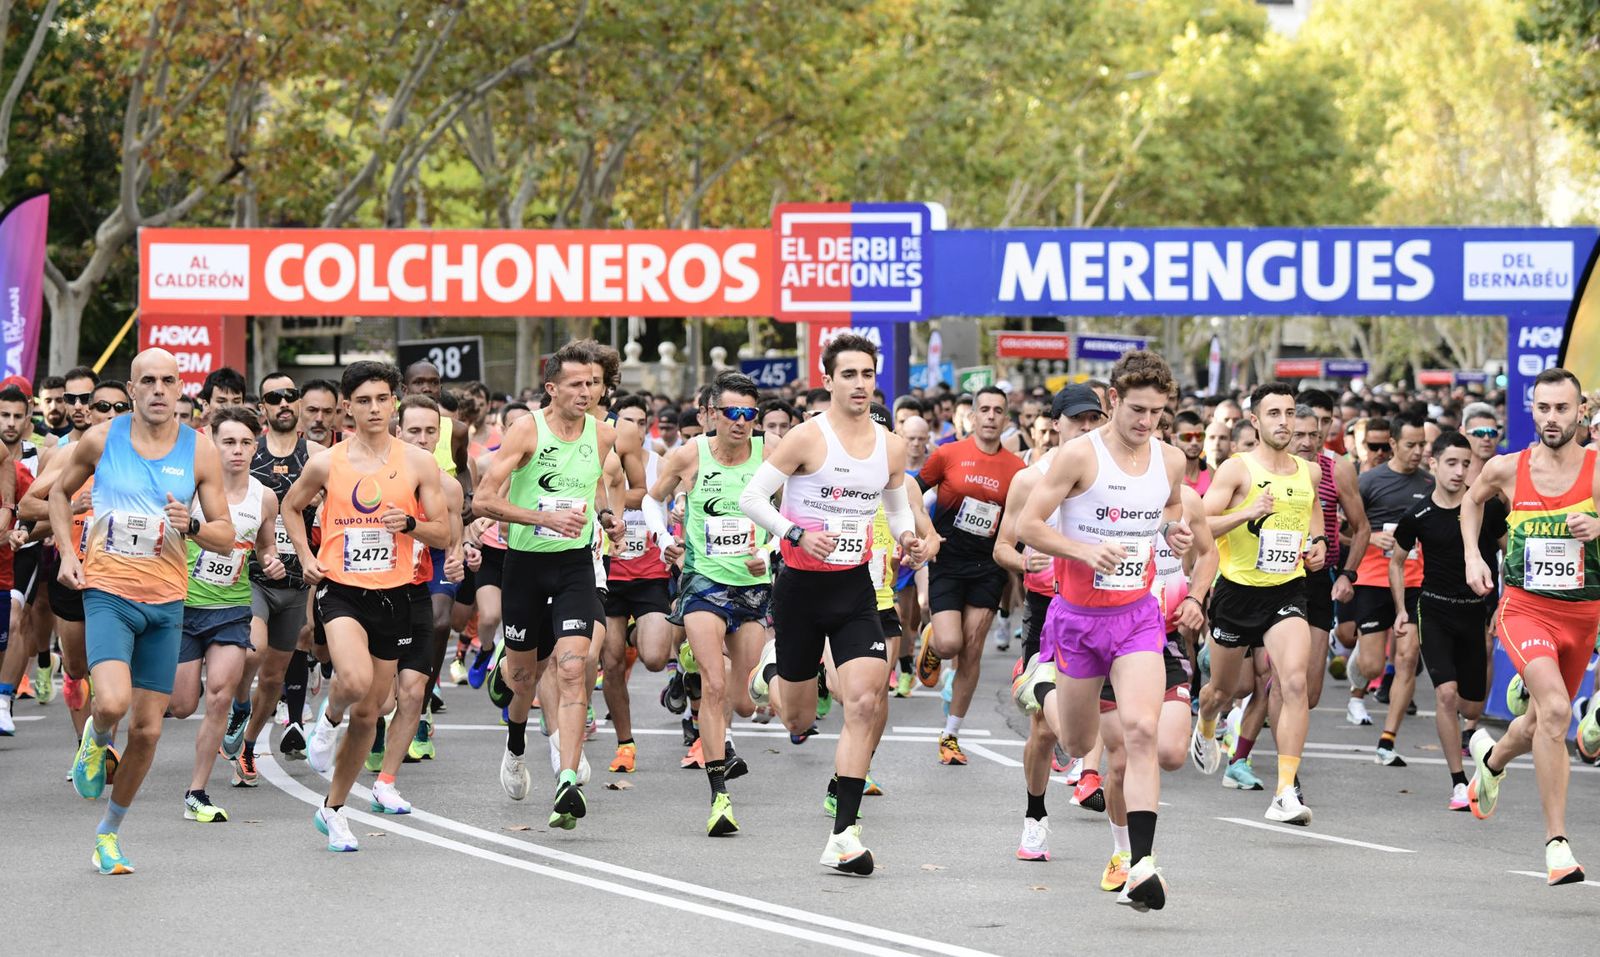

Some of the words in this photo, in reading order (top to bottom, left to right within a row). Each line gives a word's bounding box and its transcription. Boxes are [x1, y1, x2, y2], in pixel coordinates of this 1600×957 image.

[781, 237, 813, 262] EL
[818, 237, 897, 262] DERBI
[901, 237, 921, 250] DE
[190, 255, 210, 269] AL
[1502, 253, 1535, 268] DEL
[154, 269, 244, 288] CALDERÓN
[264, 242, 760, 303] COLCHONEROS
[781, 262, 923, 288] AFICIONES
[998, 239, 1434, 302] MERENGUES
[1468, 267, 1569, 288] BERNABÉU
[149, 325, 210, 346] HOKA
[161, 465, 185, 477] HOKA
[964, 473, 999, 489] NABICO
[334, 517, 363, 526] GRUPO
[964, 512, 992, 530] 1809
[131, 534, 138, 546] 1
[624, 541, 644, 551] 56
[713, 533, 748, 546] 4687
[352, 548, 389, 561] 2472
[1266, 549, 1297, 563] 3755
[206, 561, 233, 577] 389
[1534, 561, 1575, 577] 7596
